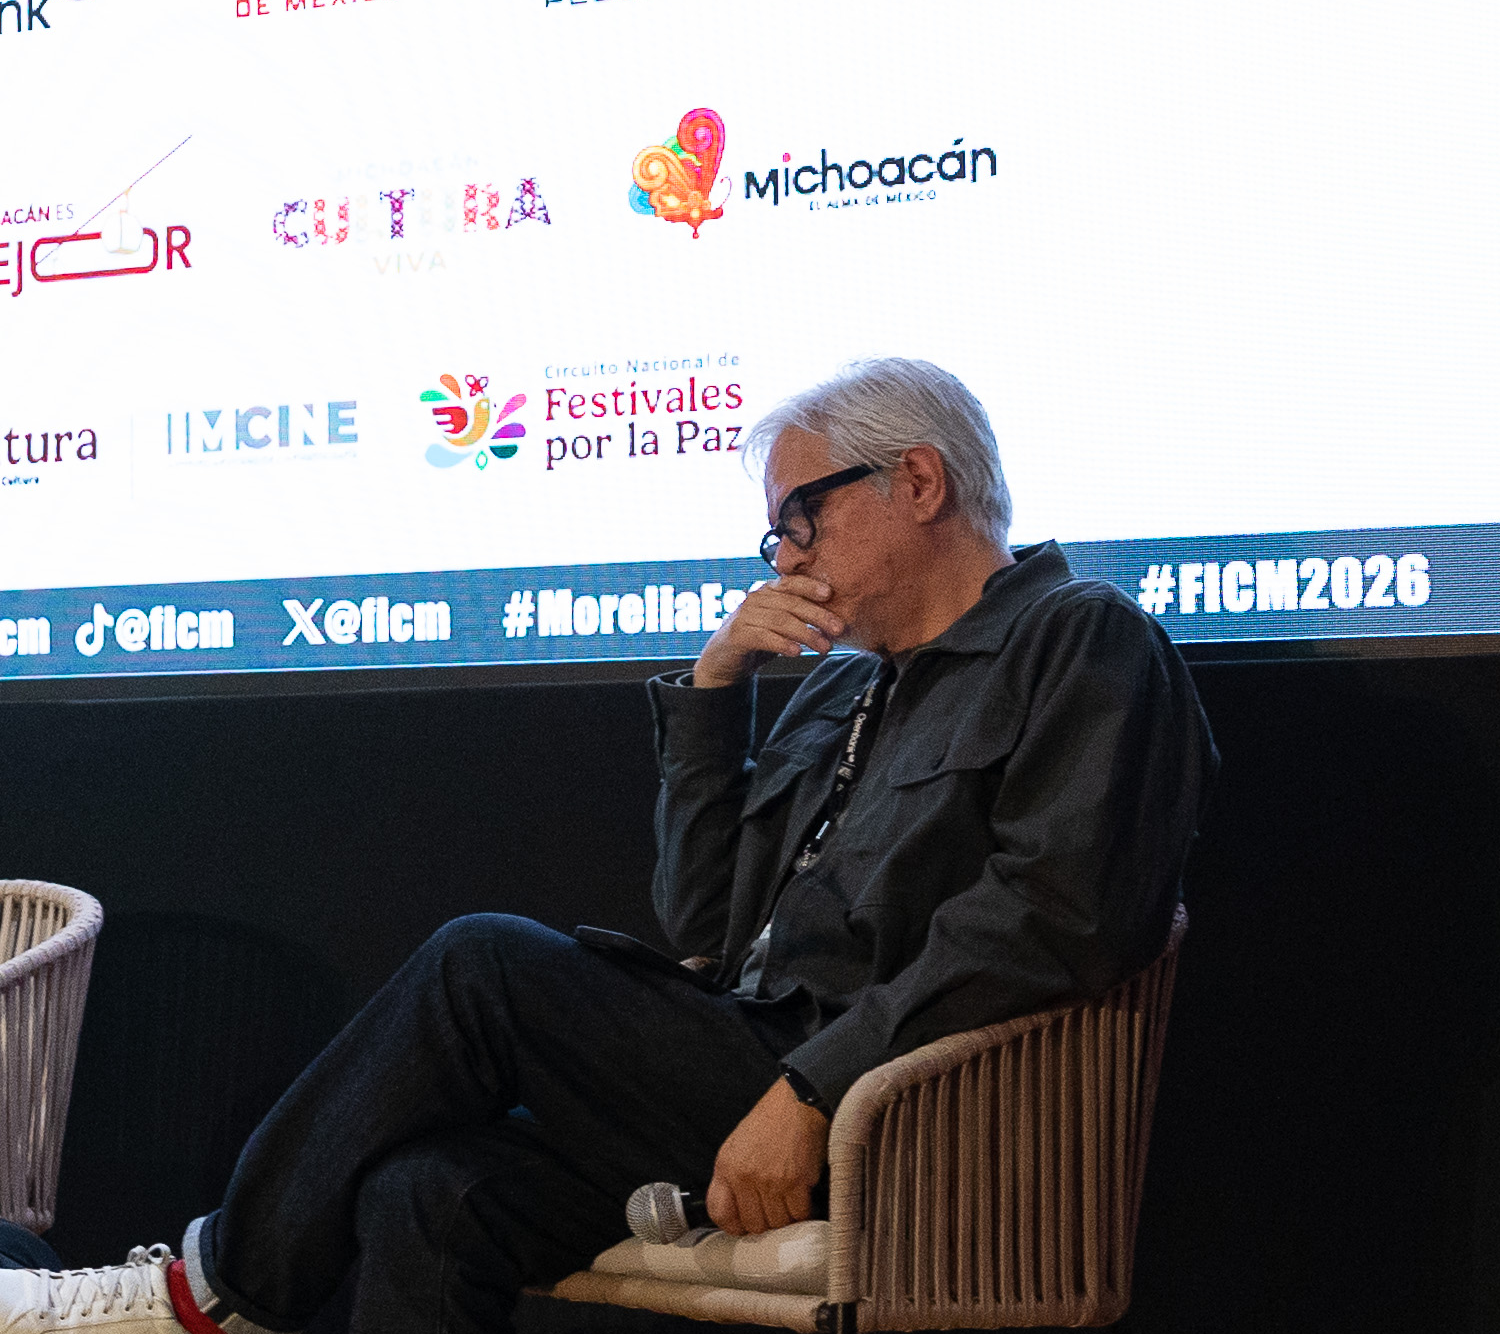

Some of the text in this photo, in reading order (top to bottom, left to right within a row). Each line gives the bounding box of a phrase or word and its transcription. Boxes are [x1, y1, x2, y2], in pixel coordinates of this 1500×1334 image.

[745, 138, 997, 206] Michoacán
[544, 352, 740, 379] Circuito Nacional de
[546, 377, 743, 421] Festivales
[546, 421, 742, 470] por la Paz
[504, 582, 765, 636] #MoreliaEs
[1139, 555, 1429, 613] #FICM2026
